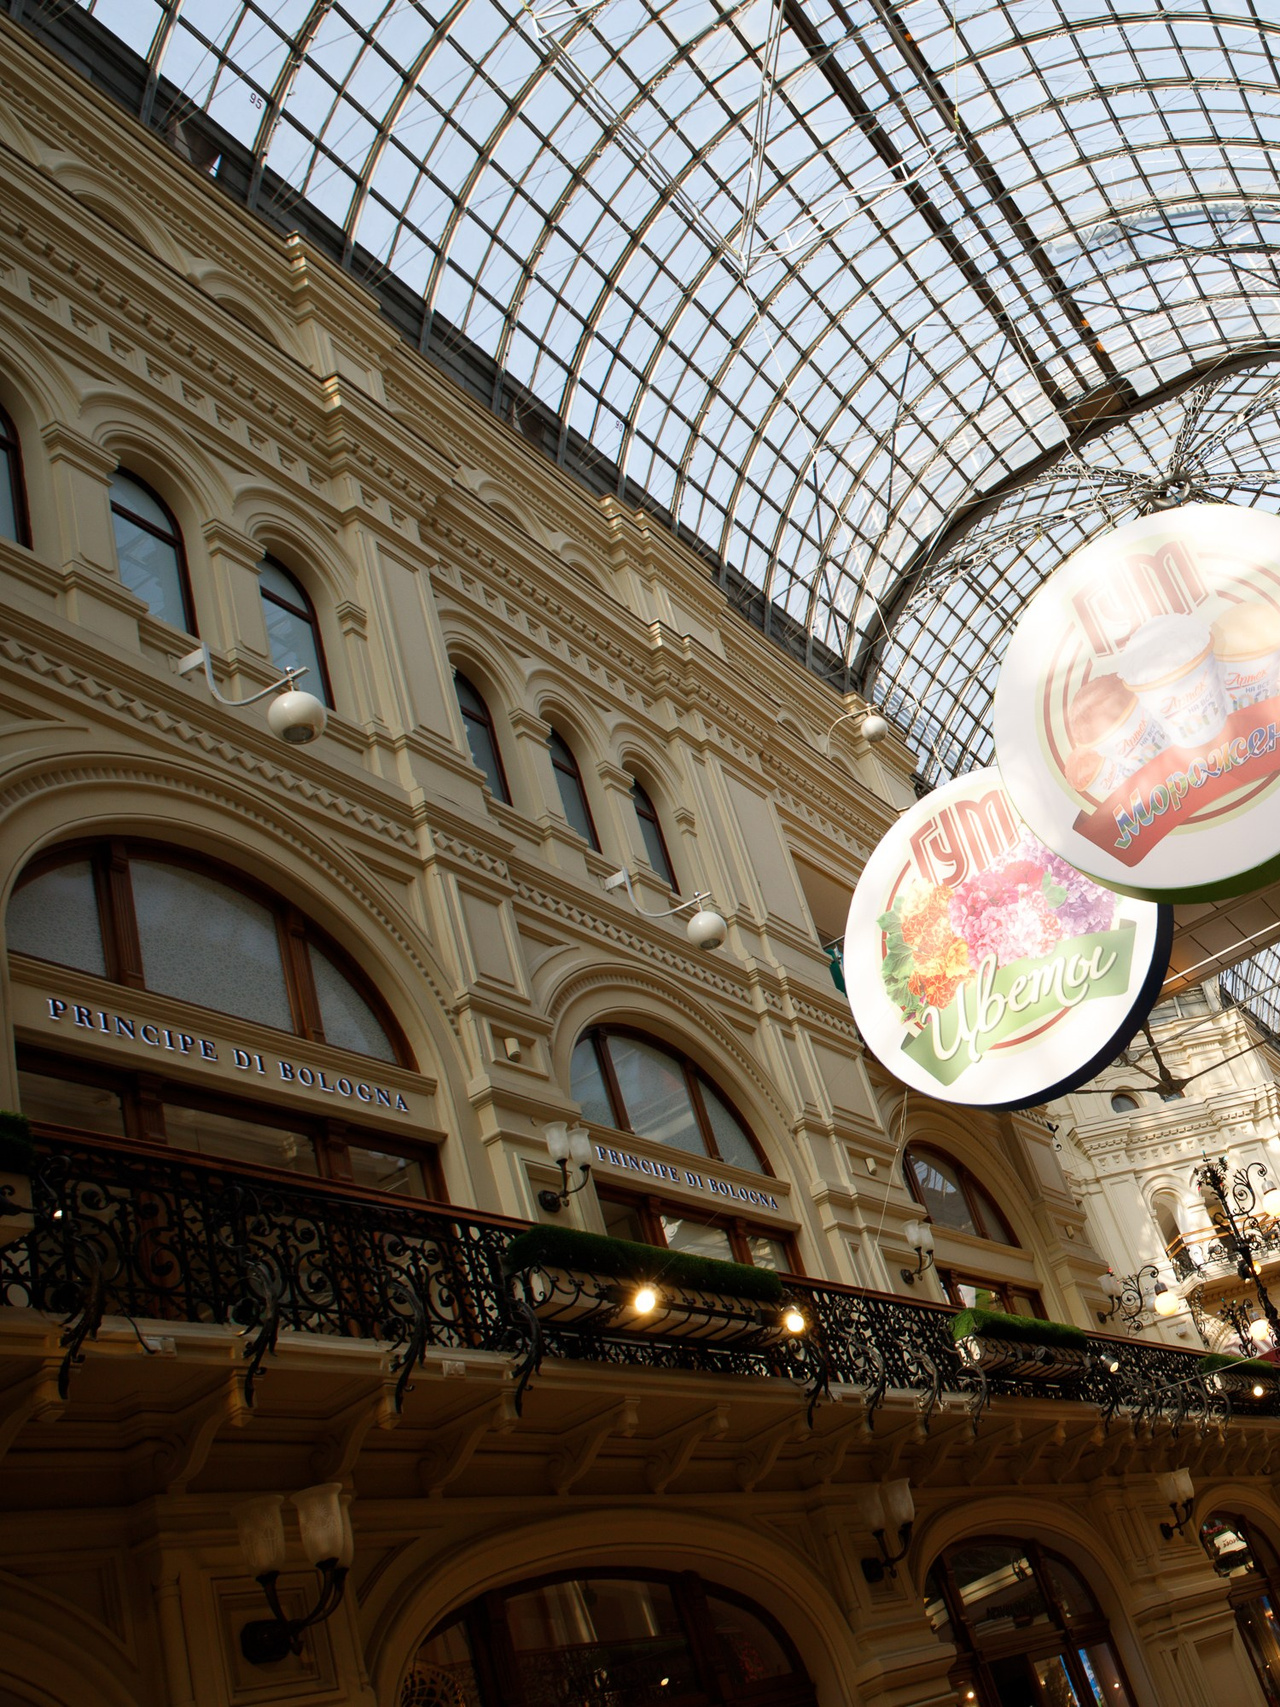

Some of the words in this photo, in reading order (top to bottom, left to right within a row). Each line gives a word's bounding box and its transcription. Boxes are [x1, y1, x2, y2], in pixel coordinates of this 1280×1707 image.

[249, 92, 263, 110] 95
[921, 945, 1118, 1063] Цветы
[47, 997, 219, 1062] PRINCIPE
[233, 1048, 266, 1075] DI
[278, 1061, 410, 1113] BOLOGNA
[594, 1145, 680, 1183] PRINCIPE
[684, 1171, 704, 1189] DI
[708, 1178, 780, 1211] BOLOGNA
